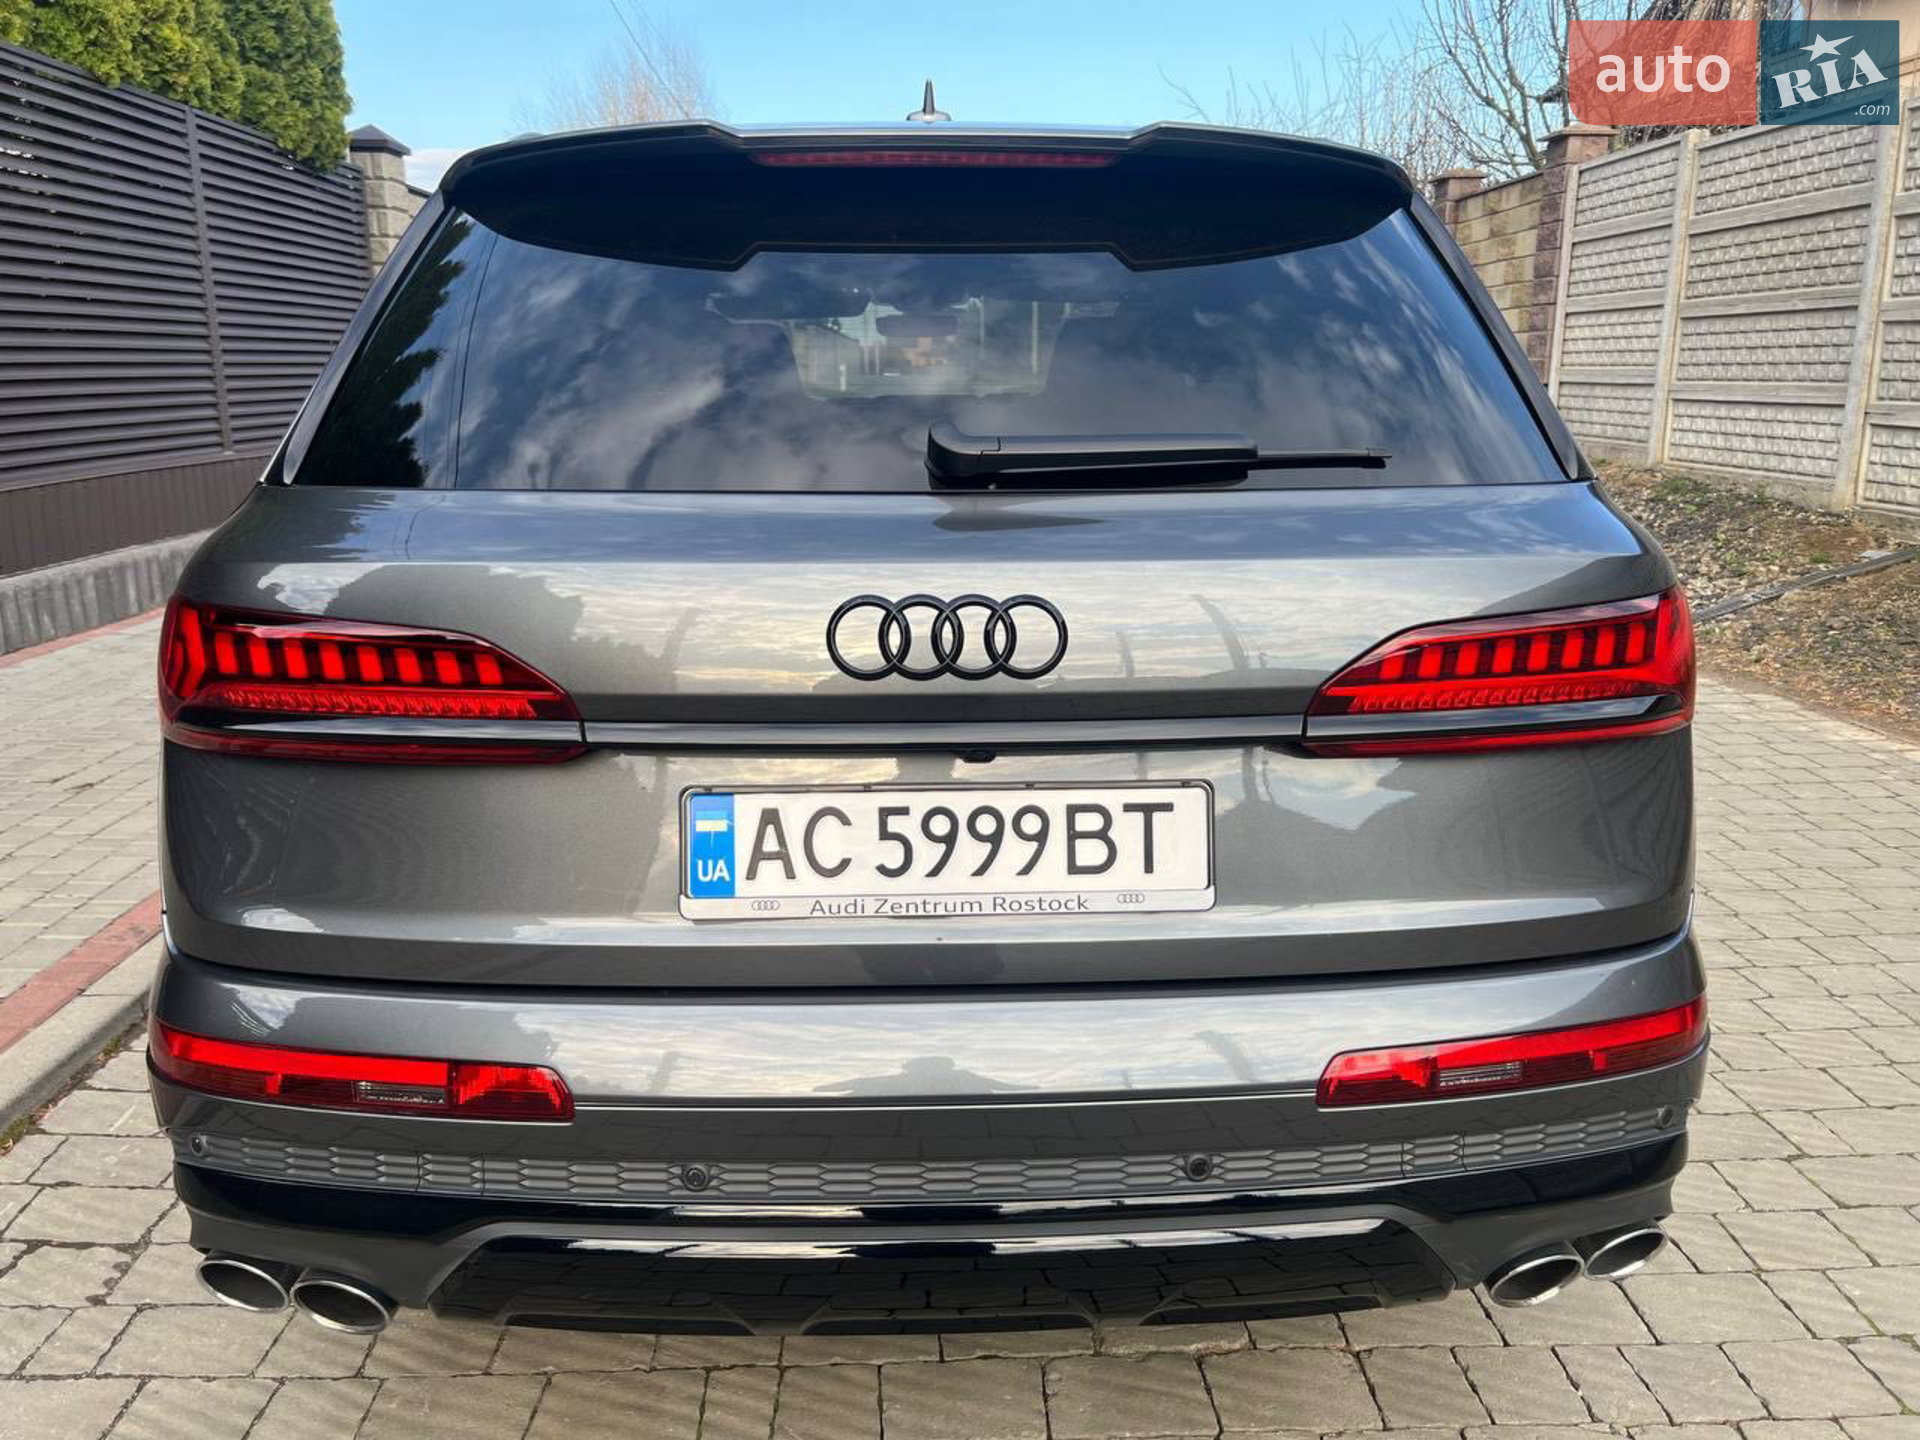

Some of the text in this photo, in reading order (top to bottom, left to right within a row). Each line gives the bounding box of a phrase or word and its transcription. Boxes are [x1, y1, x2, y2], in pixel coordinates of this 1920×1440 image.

[697, 859, 730, 882] UA
[809, 895, 1090, 916] Audi Zentrum Rostock
